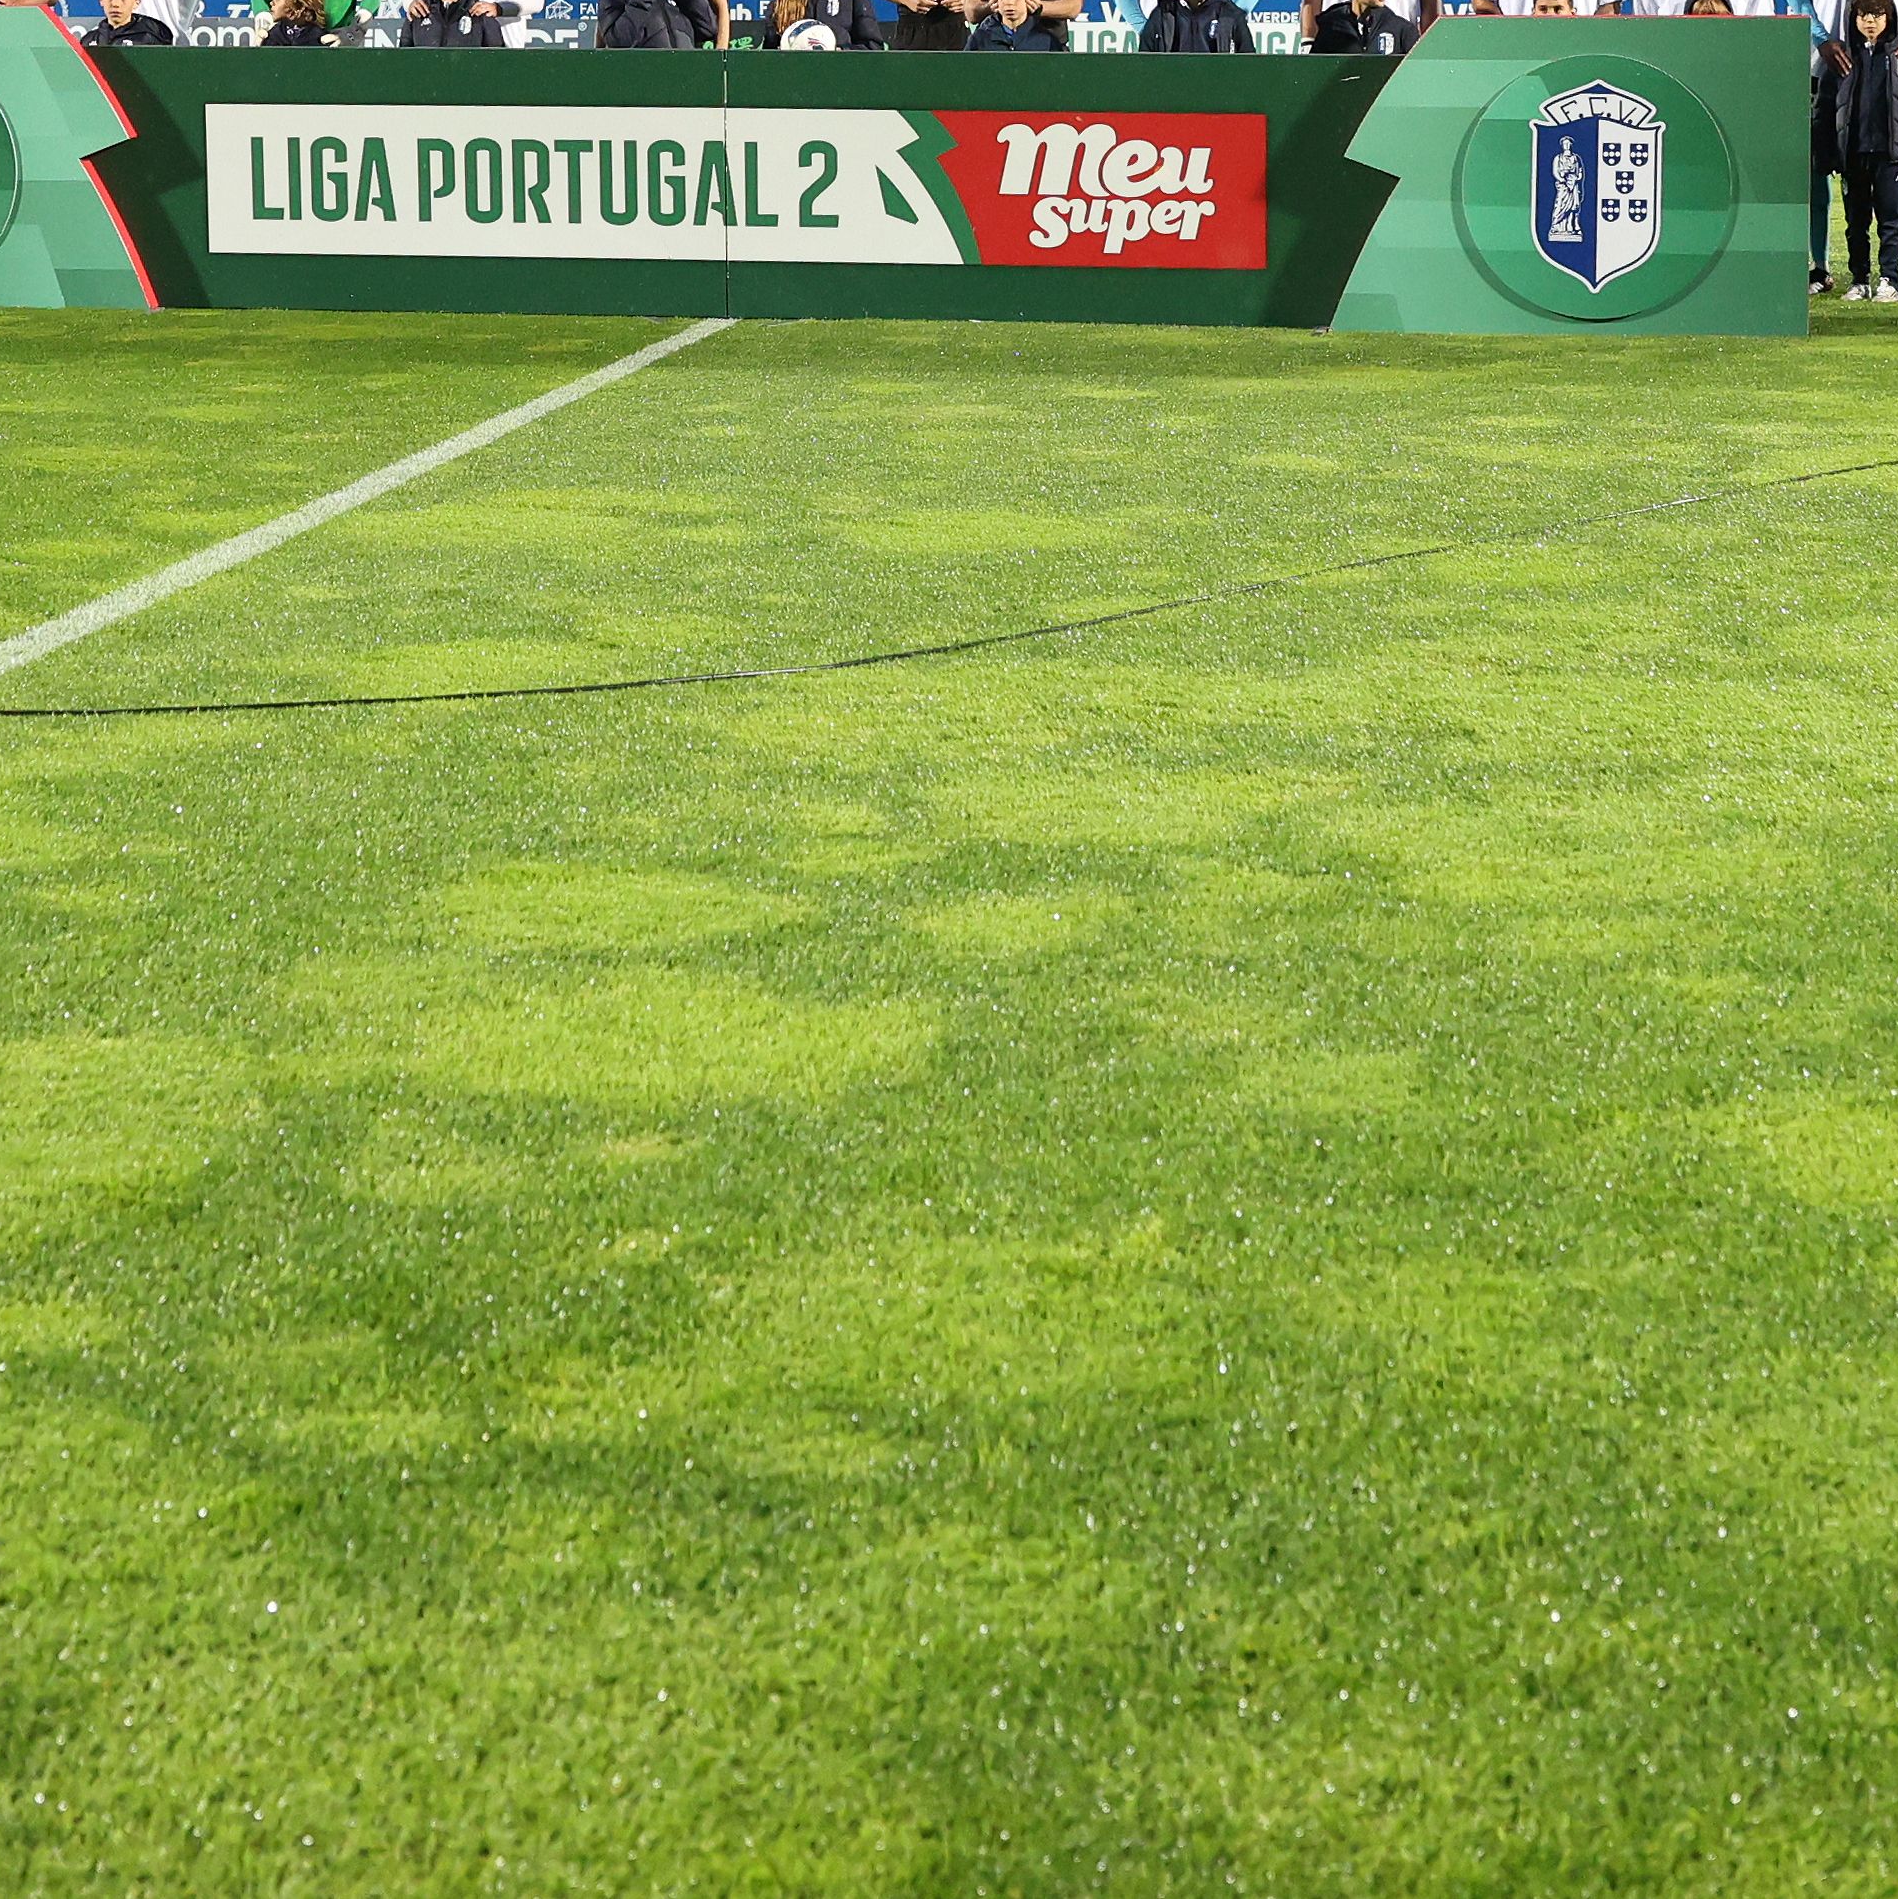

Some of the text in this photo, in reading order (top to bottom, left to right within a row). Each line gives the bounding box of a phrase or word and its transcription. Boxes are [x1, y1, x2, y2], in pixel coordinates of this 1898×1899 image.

[250, 136, 840, 228] LIGA PORTUGAL 2
[996, 122, 1214, 198] Meu
[1029, 196, 1216, 254] super
